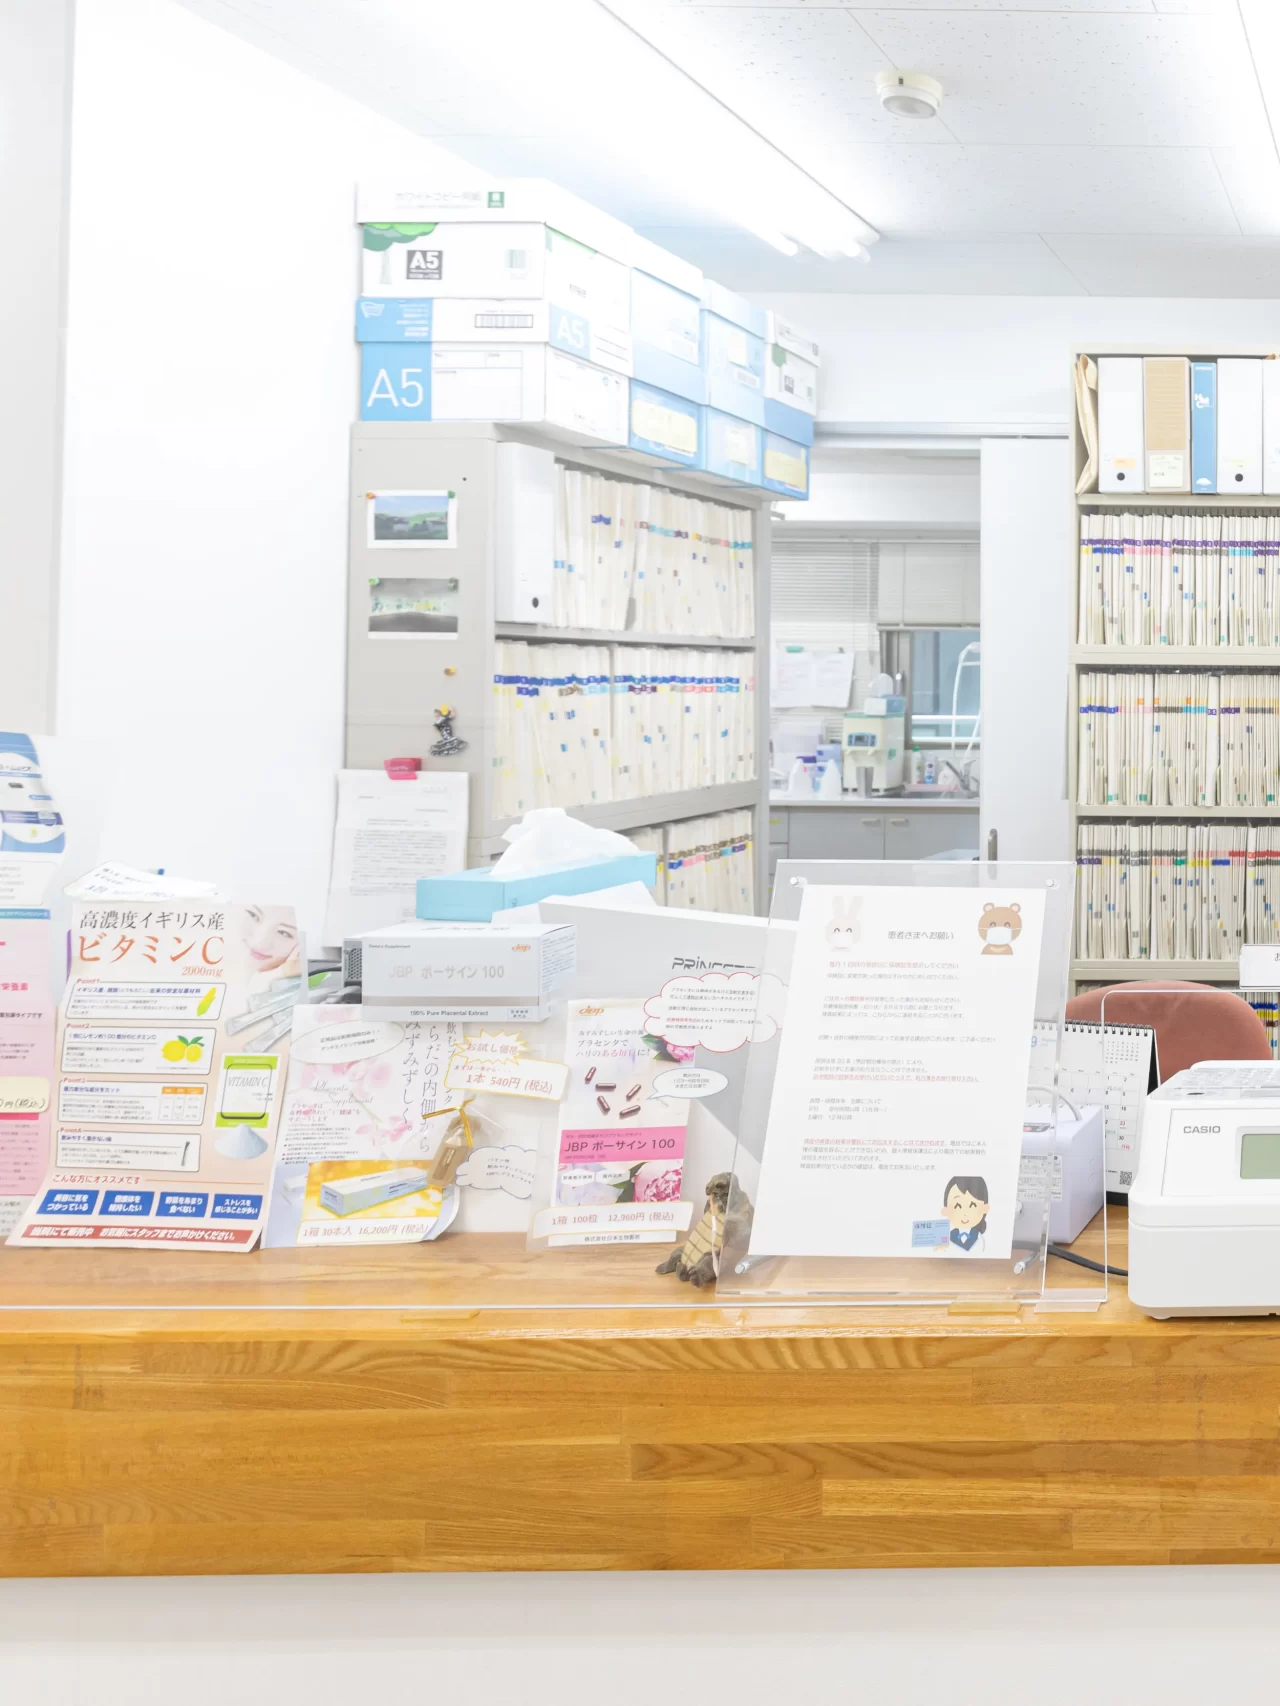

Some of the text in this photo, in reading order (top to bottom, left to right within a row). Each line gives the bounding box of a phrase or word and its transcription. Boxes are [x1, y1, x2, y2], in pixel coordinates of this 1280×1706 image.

[409, 251, 440, 269] A5
[556, 315, 586, 348] A5
[366, 368, 424, 408] A5
[79, 910, 225, 930] 高濃度イギリス産
[888, 930, 955, 940] 患者さまへお願い
[79, 932, 225, 965] ビタミンC
[181, 965, 223, 977] 2000mg
[483, 965, 505, 979] 100
[1030, 1035, 1038, 1048] 9
[466, 1042, 518, 1055] お試し価格
[227, 1076, 268, 1088] VITAMIN C
[466, 1072, 552, 1094] 1本 540円 (税込)
[1183, 1125, 1221, 1134] CASIO
[564, 1141, 588, 1153] JBP
[651, 1138, 676, 1149] 100
[52, 1173, 141, 1185] こんな方にオススメです
[47, 1203, 89, 1212] つかっている
[223, 1198, 252, 1207] ストレスを
[168, 1205, 196, 1214] 食べない
[552, 1216, 568, 1226] 1箱
[608, 1212, 645, 1222] 12,960円
[649, 1211, 674, 1221] (税込)
[302, 1223, 429, 1237] 1箱 30本入 16,200円 (税込)
